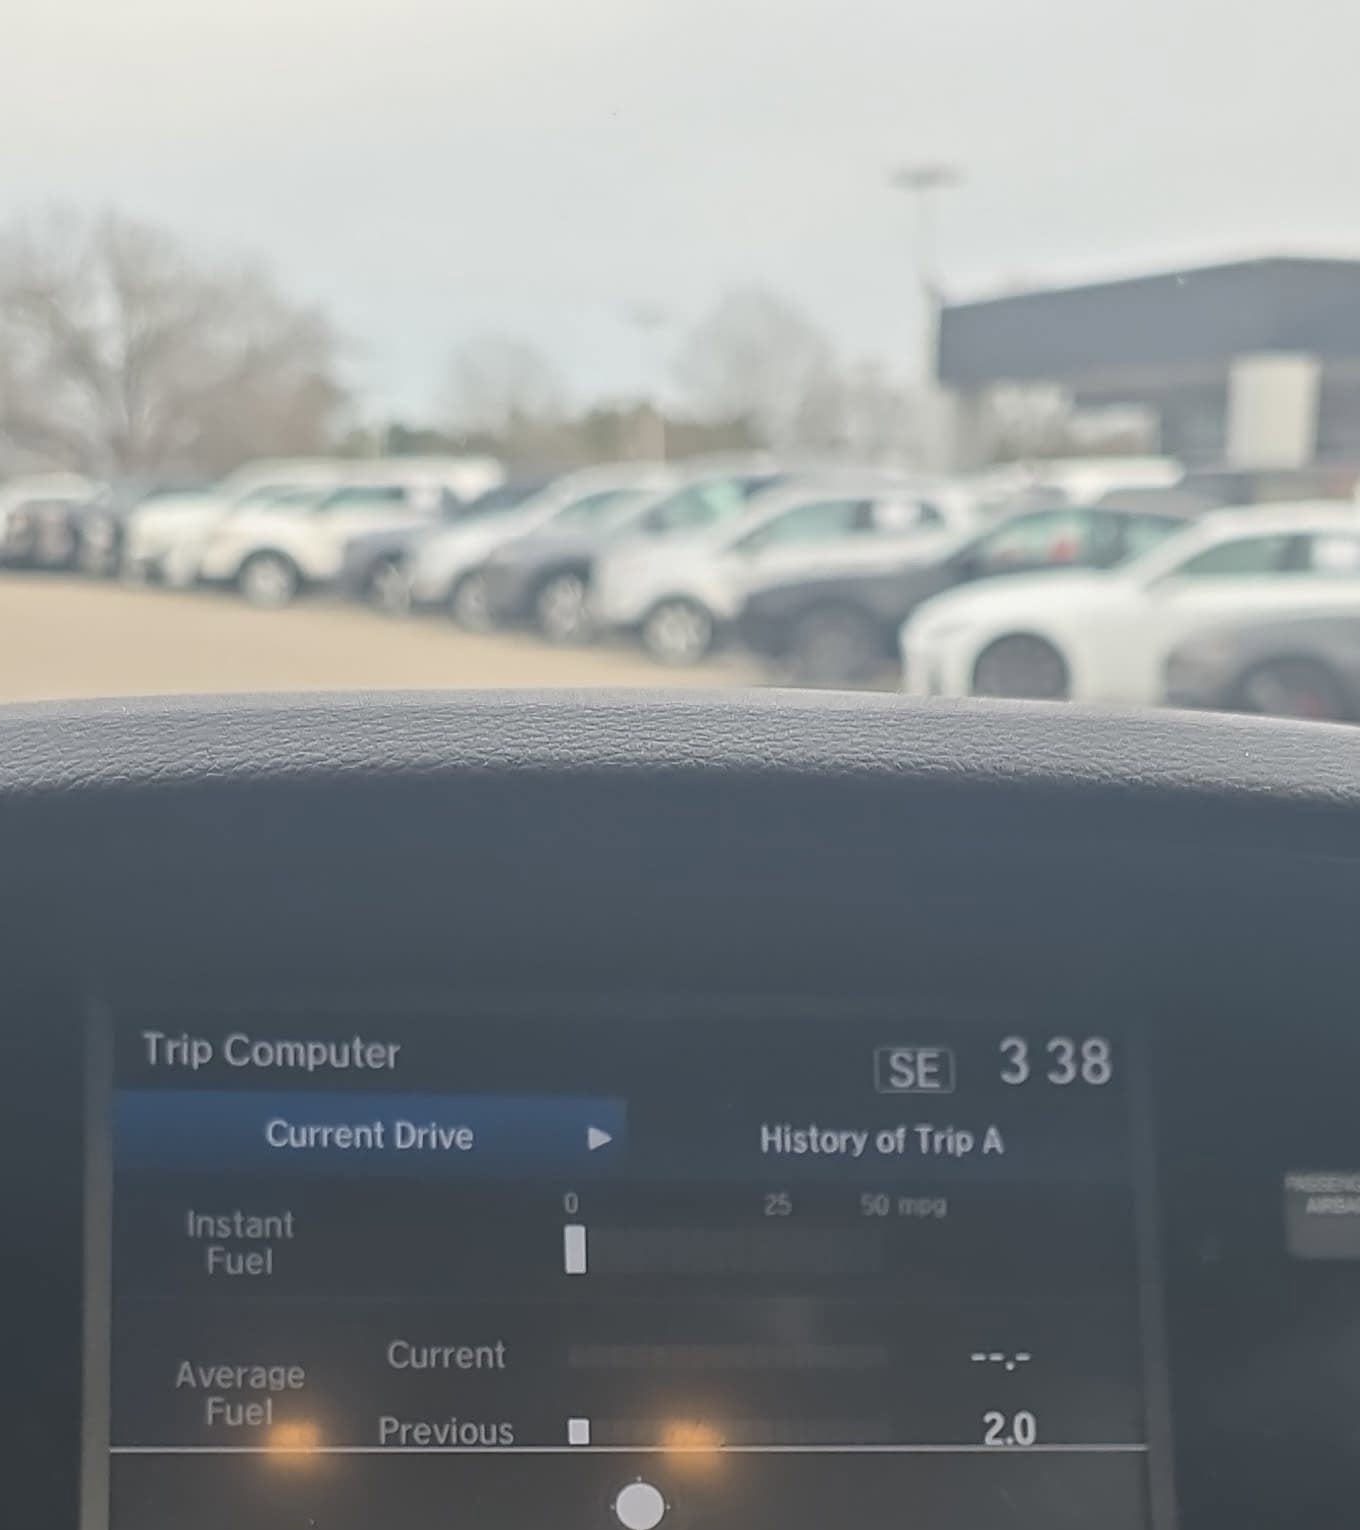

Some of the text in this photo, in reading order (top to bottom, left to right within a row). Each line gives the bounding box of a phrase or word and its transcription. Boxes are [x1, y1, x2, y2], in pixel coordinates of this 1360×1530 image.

[143, 1031, 401, 1070] Trip Computer
[889, 1050, 941, 1089] SE
[265, 1120, 475, 1150] Current Drive
[760, 1125, 1004, 1157] History of Trip A
[564, 1192, 579, 1214] 0
[764, 1194, 792, 1215] 25
[861, 1194, 947, 1218] 50 mpg
[187, 1209, 295, 1239] Instant
[206, 1246, 273, 1275] Fuel
[387, 1340, 506, 1370] Current
[176, 1362, 305, 1391] Average
[205, 1397, 273, 1426] Fuel
[379, 1416, 514, 1446] Previous
[983, 1411, 1037, 1446] 2.0
